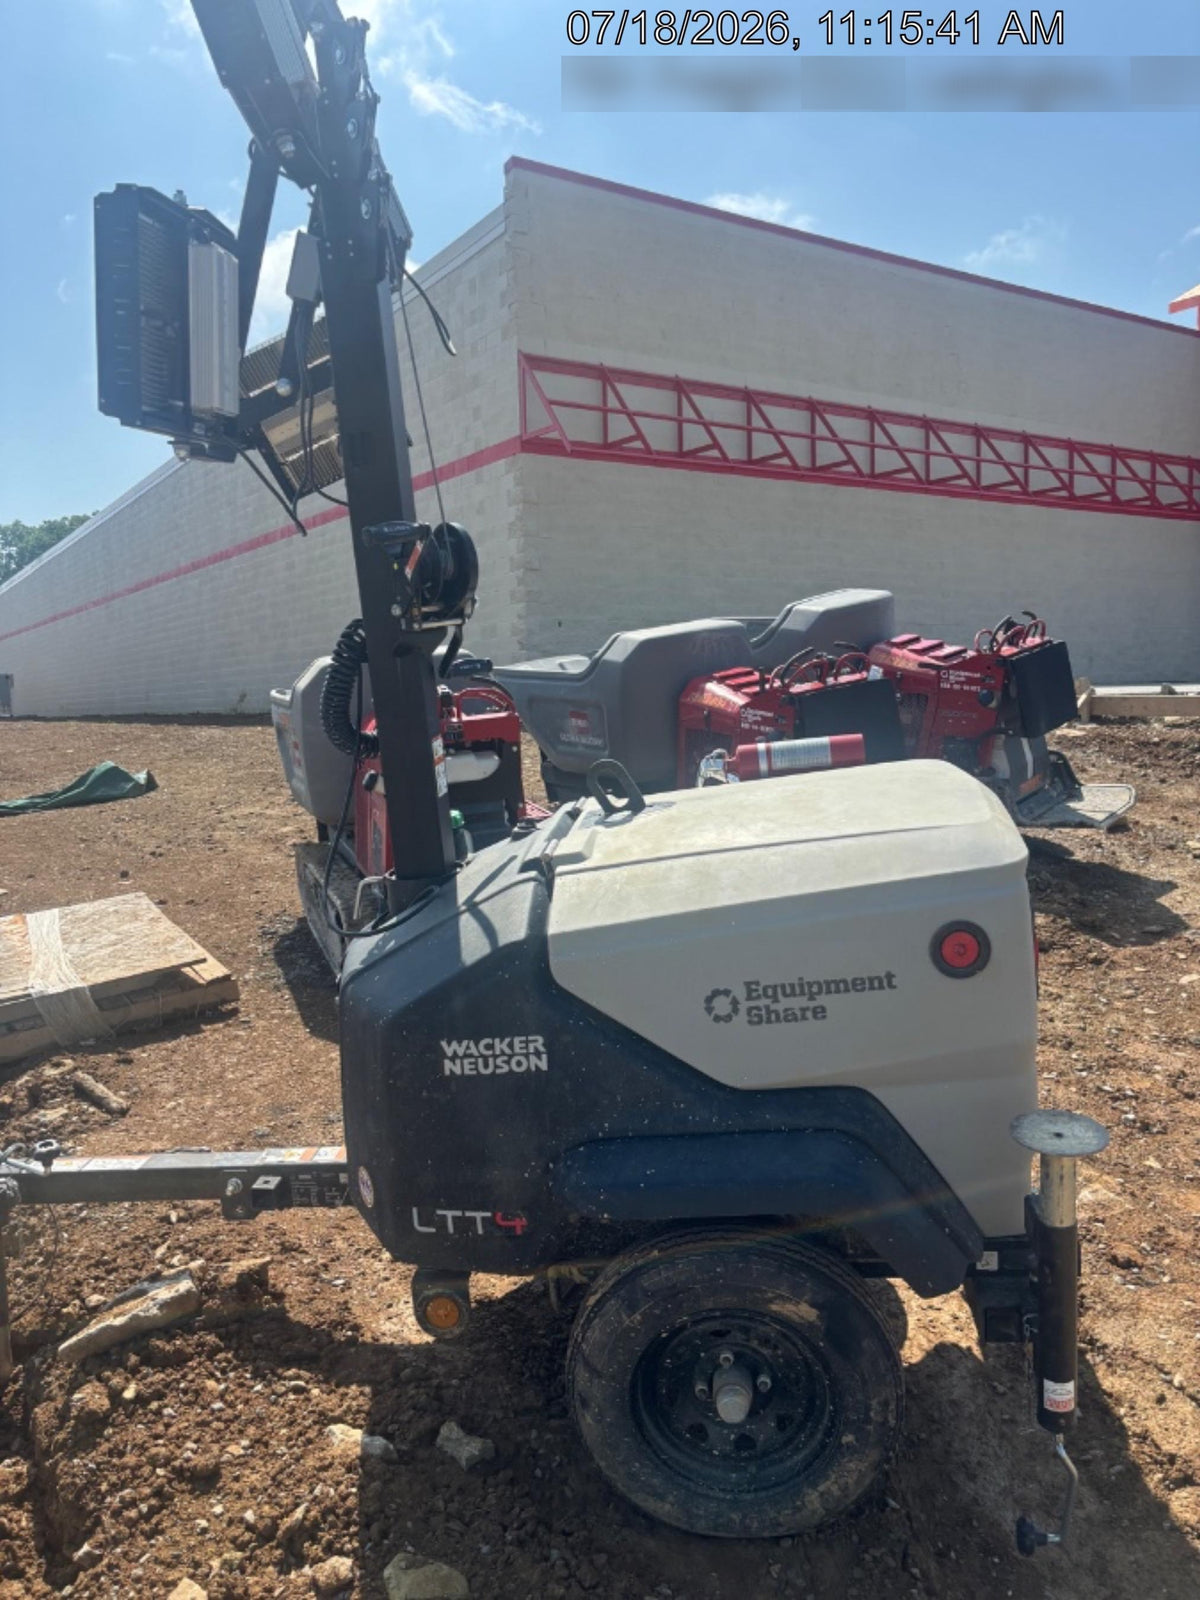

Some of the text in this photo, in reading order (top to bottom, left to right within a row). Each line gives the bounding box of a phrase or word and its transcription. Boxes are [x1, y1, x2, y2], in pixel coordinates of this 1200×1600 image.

[743, 970, 897, 1004] Equipment
[746, 1003, 827, 1026] Share
[440, 1035, 547, 1057] WACKER
[443, 1053, 548, 1076] NEUSON
[412, 1206, 528, 1235] LTT4
